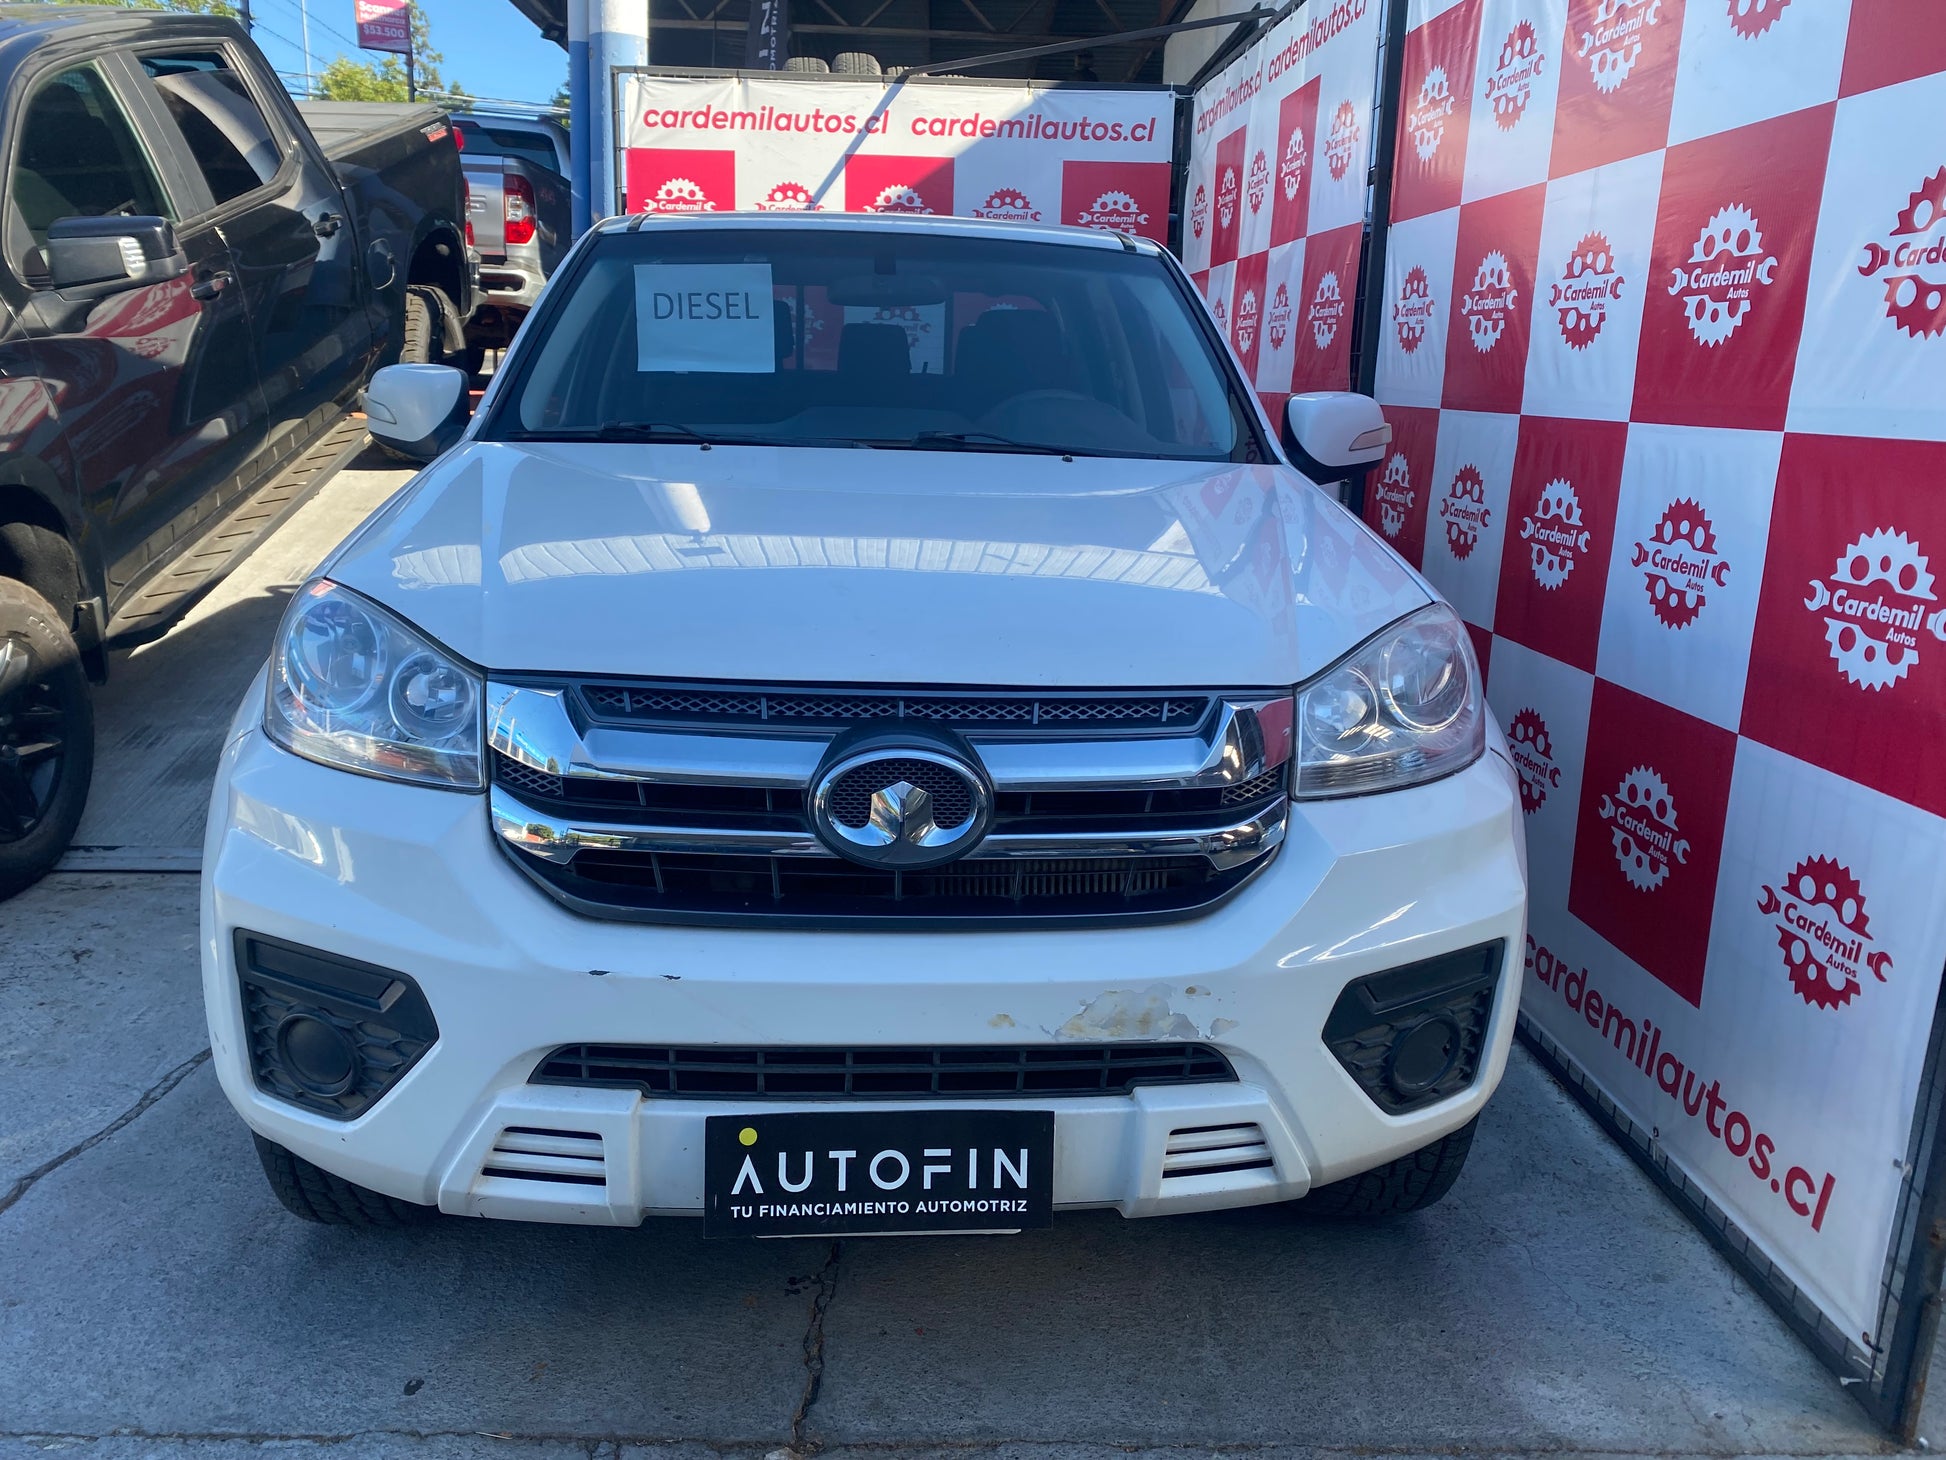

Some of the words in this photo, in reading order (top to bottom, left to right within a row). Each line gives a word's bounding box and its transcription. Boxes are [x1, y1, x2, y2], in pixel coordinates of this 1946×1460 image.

[363, 23, 405, 38] $53.500
[1595, 6, 1645, 46] Cardemil
[1497, 62, 1532, 91] Cardemil
[1197, 60, 1263, 135] cardemilautos.cl
[643, 104, 889, 134] cardemilautos.cl
[1418, 101, 1446, 126] Cardemil
[911, 113, 1156, 142] cardemilautos.cl
[659, 201, 702, 210] Cardemil
[986, 211, 1028, 221] Cardemil
[1093, 213, 1135, 223] Cardemil
[1690, 260, 1755, 289] Cardemil
[1473, 292, 1506, 311] Cardemil
[1564, 279, 1609, 301] Cardemil
[1726, 286, 1749, 300] Autos
[653, 292, 760, 320] DIESEL
[1401, 301, 1425, 317] Cardemil
[1384, 487, 1406, 503] Cardemil
[1450, 502, 1480, 522] Cardemil
[1535, 522, 1577, 547] Cardemil
[1651, 548, 1710, 579] Cardemil
[1685, 578, 1704, 593] Autos
[1833, 589, 1925, 630] Cardemil
[1885, 627, 1916, 647] Autos
[1531, 774, 1545, 789] Autos
[1616, 807, 1672, 851] Cardemil
[1648, 845, 1668, 863] Autos
[1784, 902, 1863, 964] Cardemil
[1826, 954, 1857, 978] Autos
[731, 1148, 1028, 1195] AUTOFIN
[731, 1206, 753, 1219] TU
[759, 1201, 910, 1217] FINANCIAMIENTO
[915, 1200, 1028, 1213] AUTOMOTRIZ
